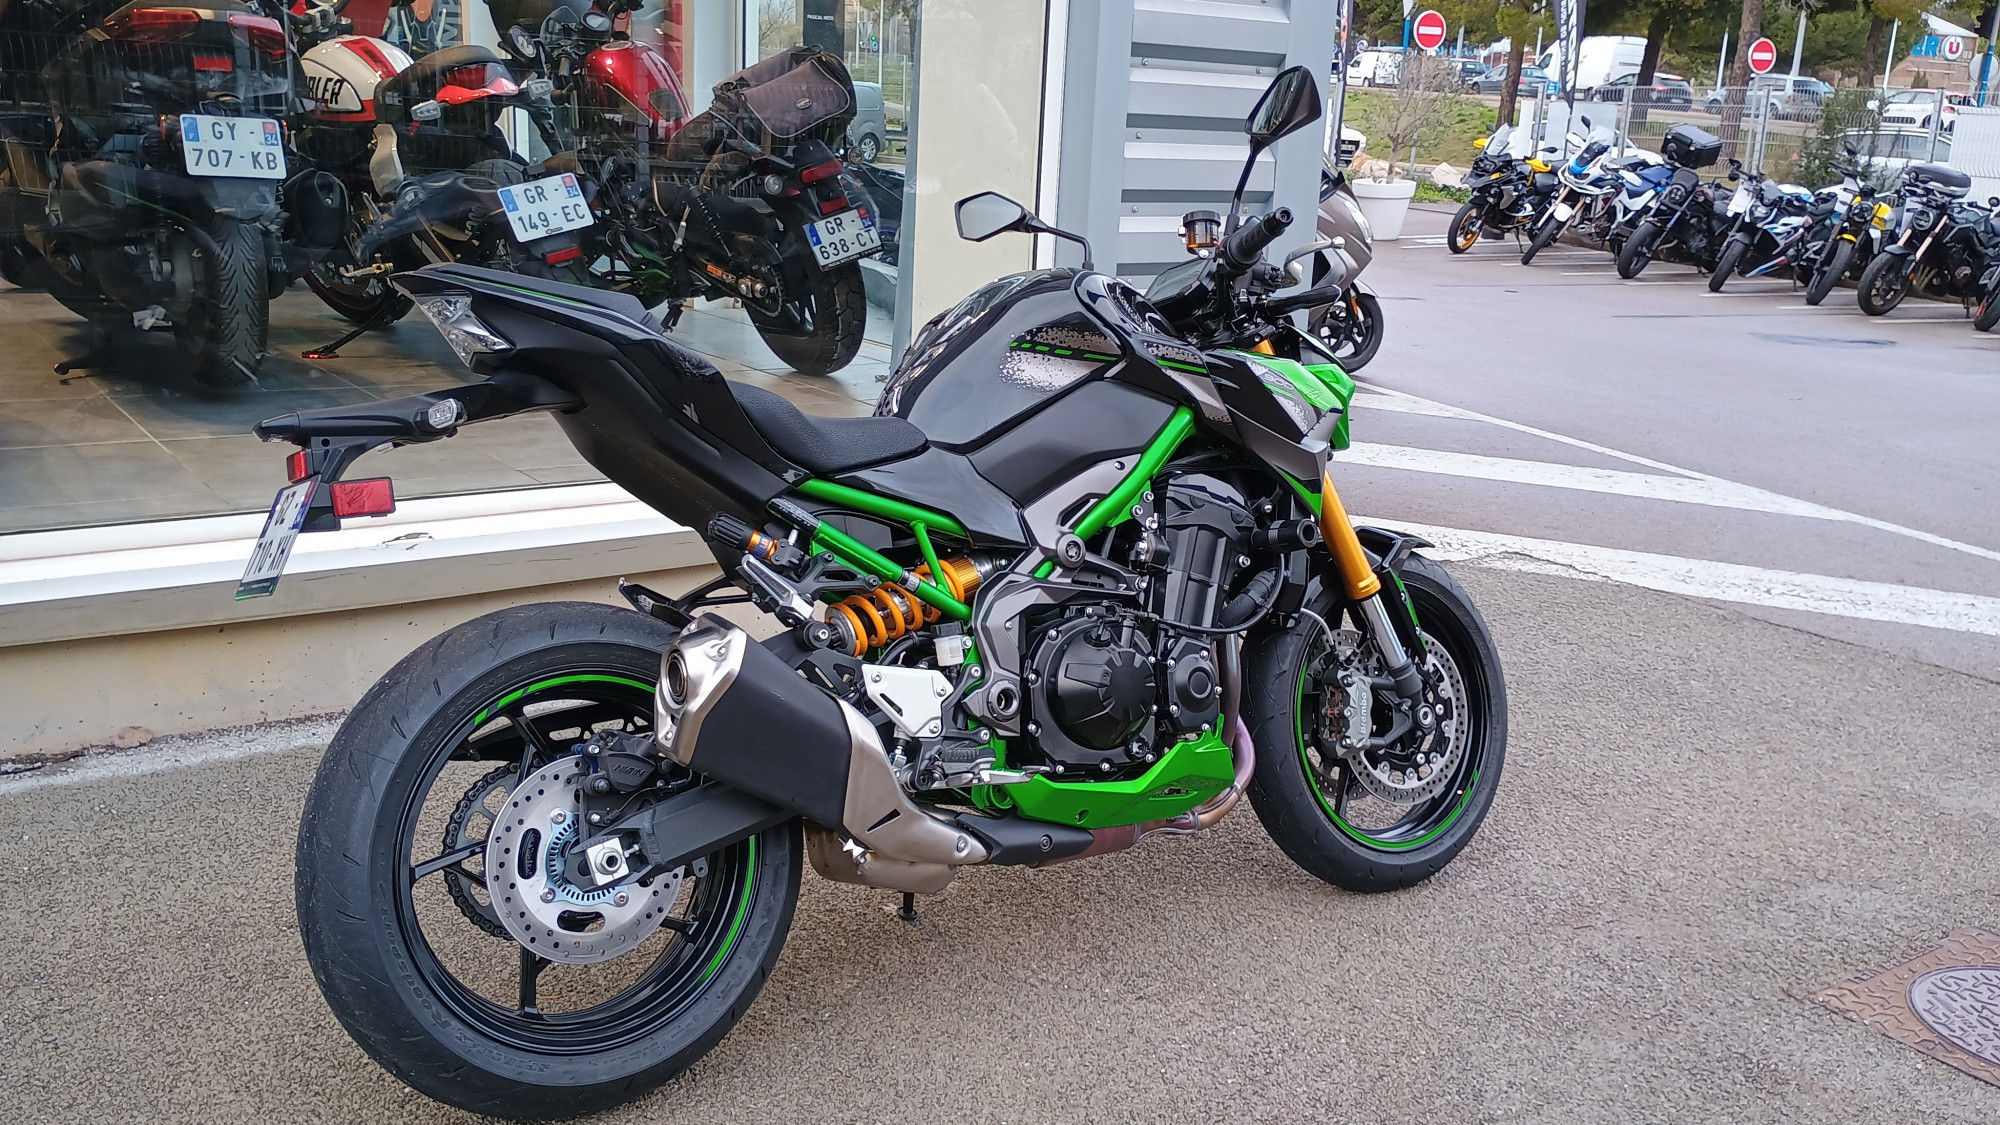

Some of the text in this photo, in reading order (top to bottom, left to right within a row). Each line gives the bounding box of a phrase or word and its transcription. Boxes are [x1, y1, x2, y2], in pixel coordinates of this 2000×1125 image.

[211, 121, 237, 141] GY
[264, 133, 278, 145] 34
[523, 185, 548, 205] GR
[824, 217, 846, 236] GR
[1359, 691, 1368, 734] brembo
